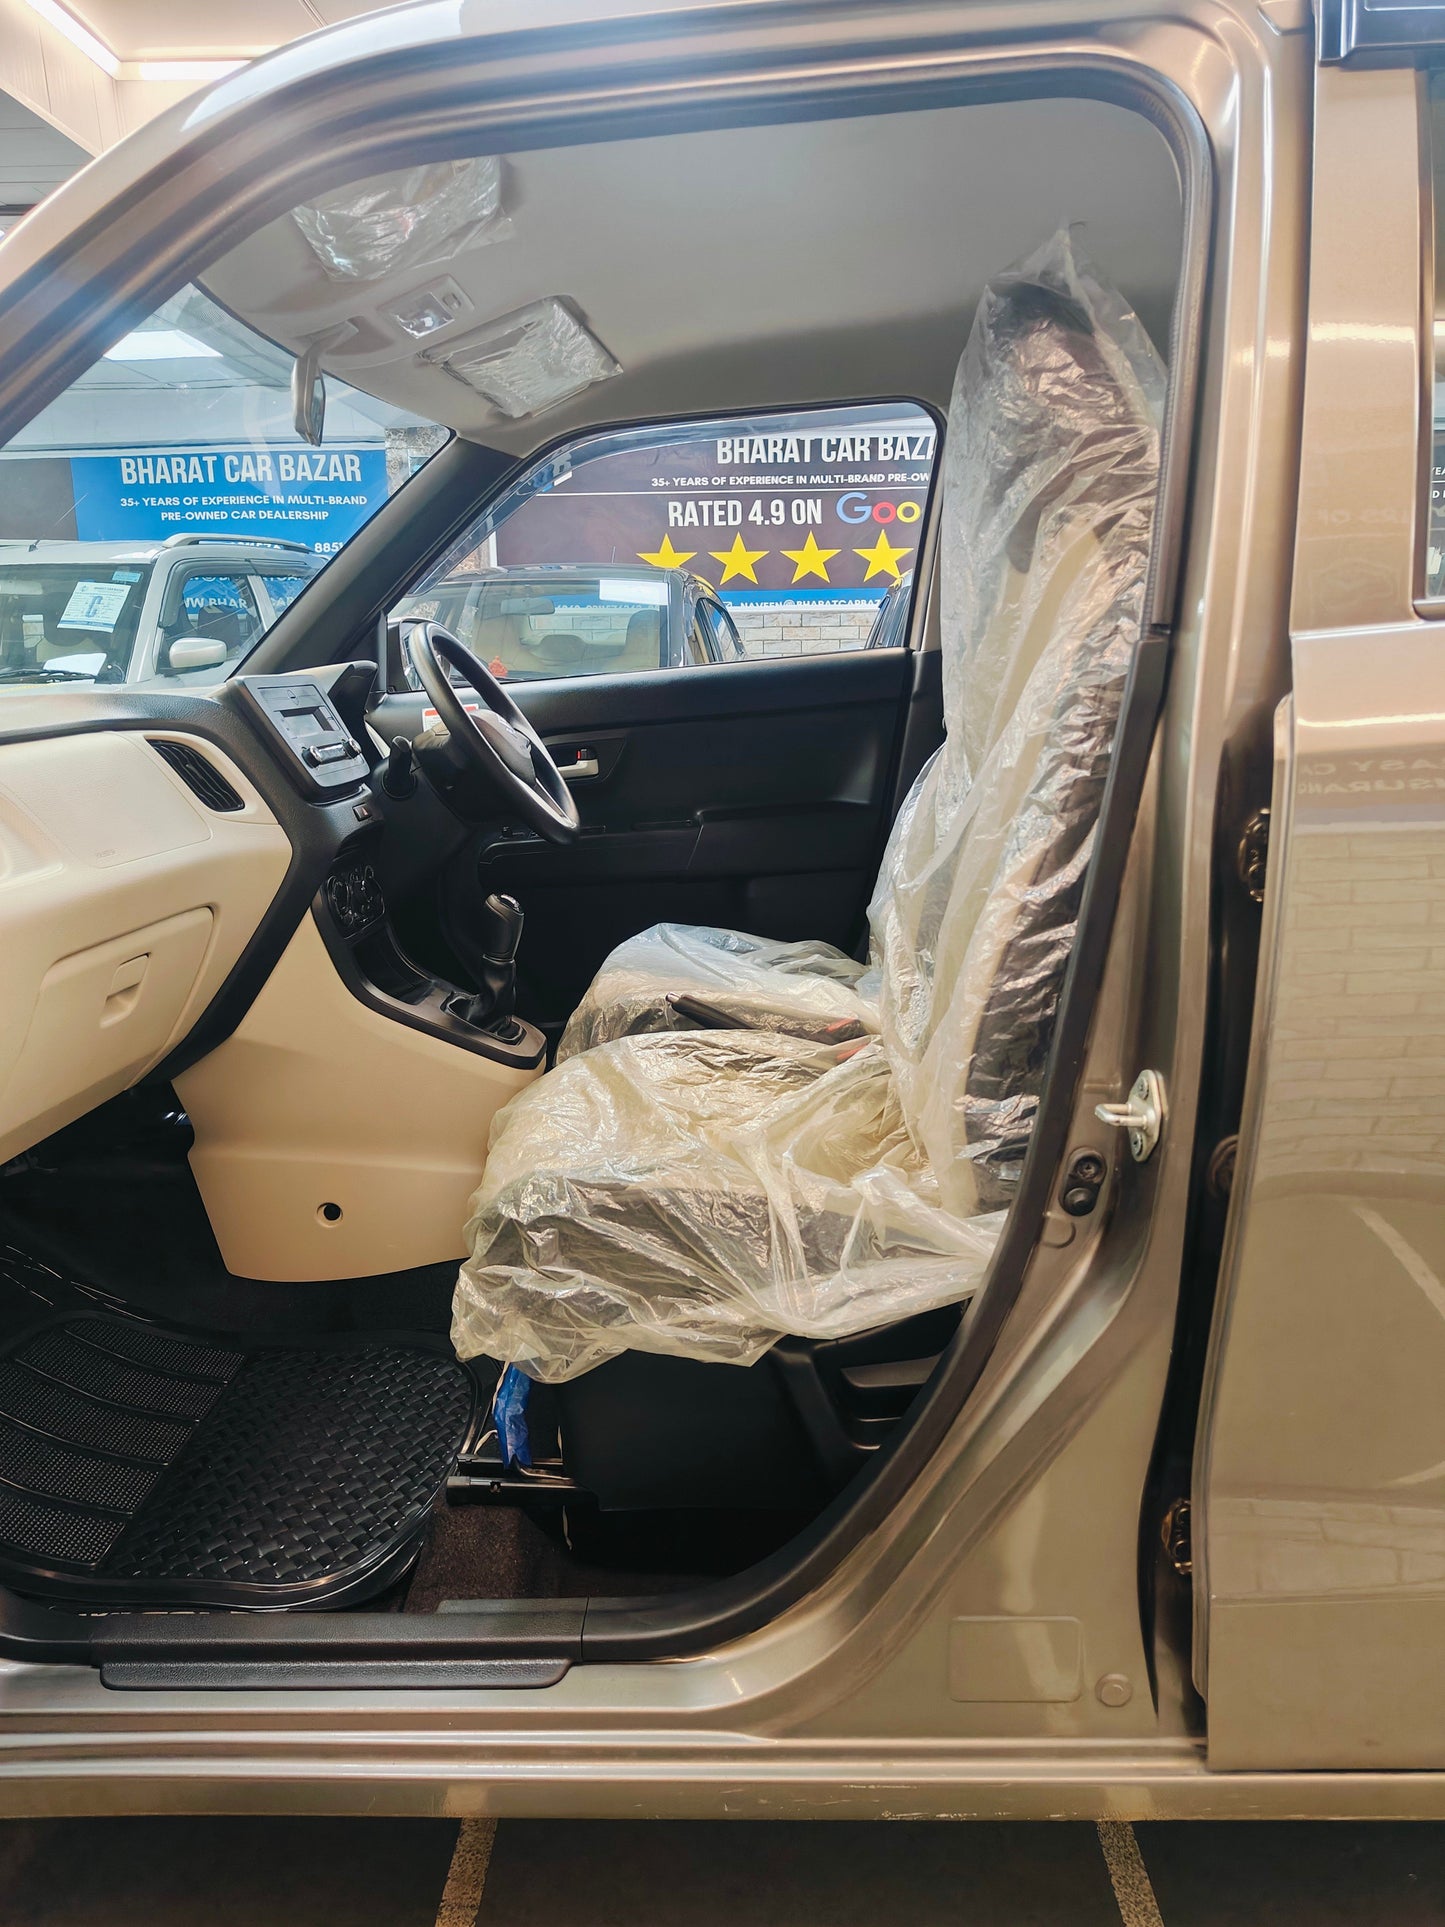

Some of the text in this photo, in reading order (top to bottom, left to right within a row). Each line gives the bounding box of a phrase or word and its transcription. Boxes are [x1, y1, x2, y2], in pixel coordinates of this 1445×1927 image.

[717, 438, 815, 464] BHARAT
[821, 437, 870, 462] CAR
[120, 453, 362, 484] BHARAT CAR BAZAR
[651, 477, 671, 487] 35+
[672, 477, 709, 486] YEARS
[711, 476, 727, 486] OF
[729, 475, 794, 485] EXPERIENCE
[796, 475, 808, 484] IN
[809, 473, 885, 484] MULTI-BRAND
[120, 495, 367, 507] 35+ YEARS OF EXPERIENCE IN MULTI-BRAND
[161, 510, 329, 521] PRE-OWNED CAR DEALERSHIP
[668, 500, 743, 527] RATED
[748, 499, 785, 525] 4.9
[792, 499, 822, 525] ON
